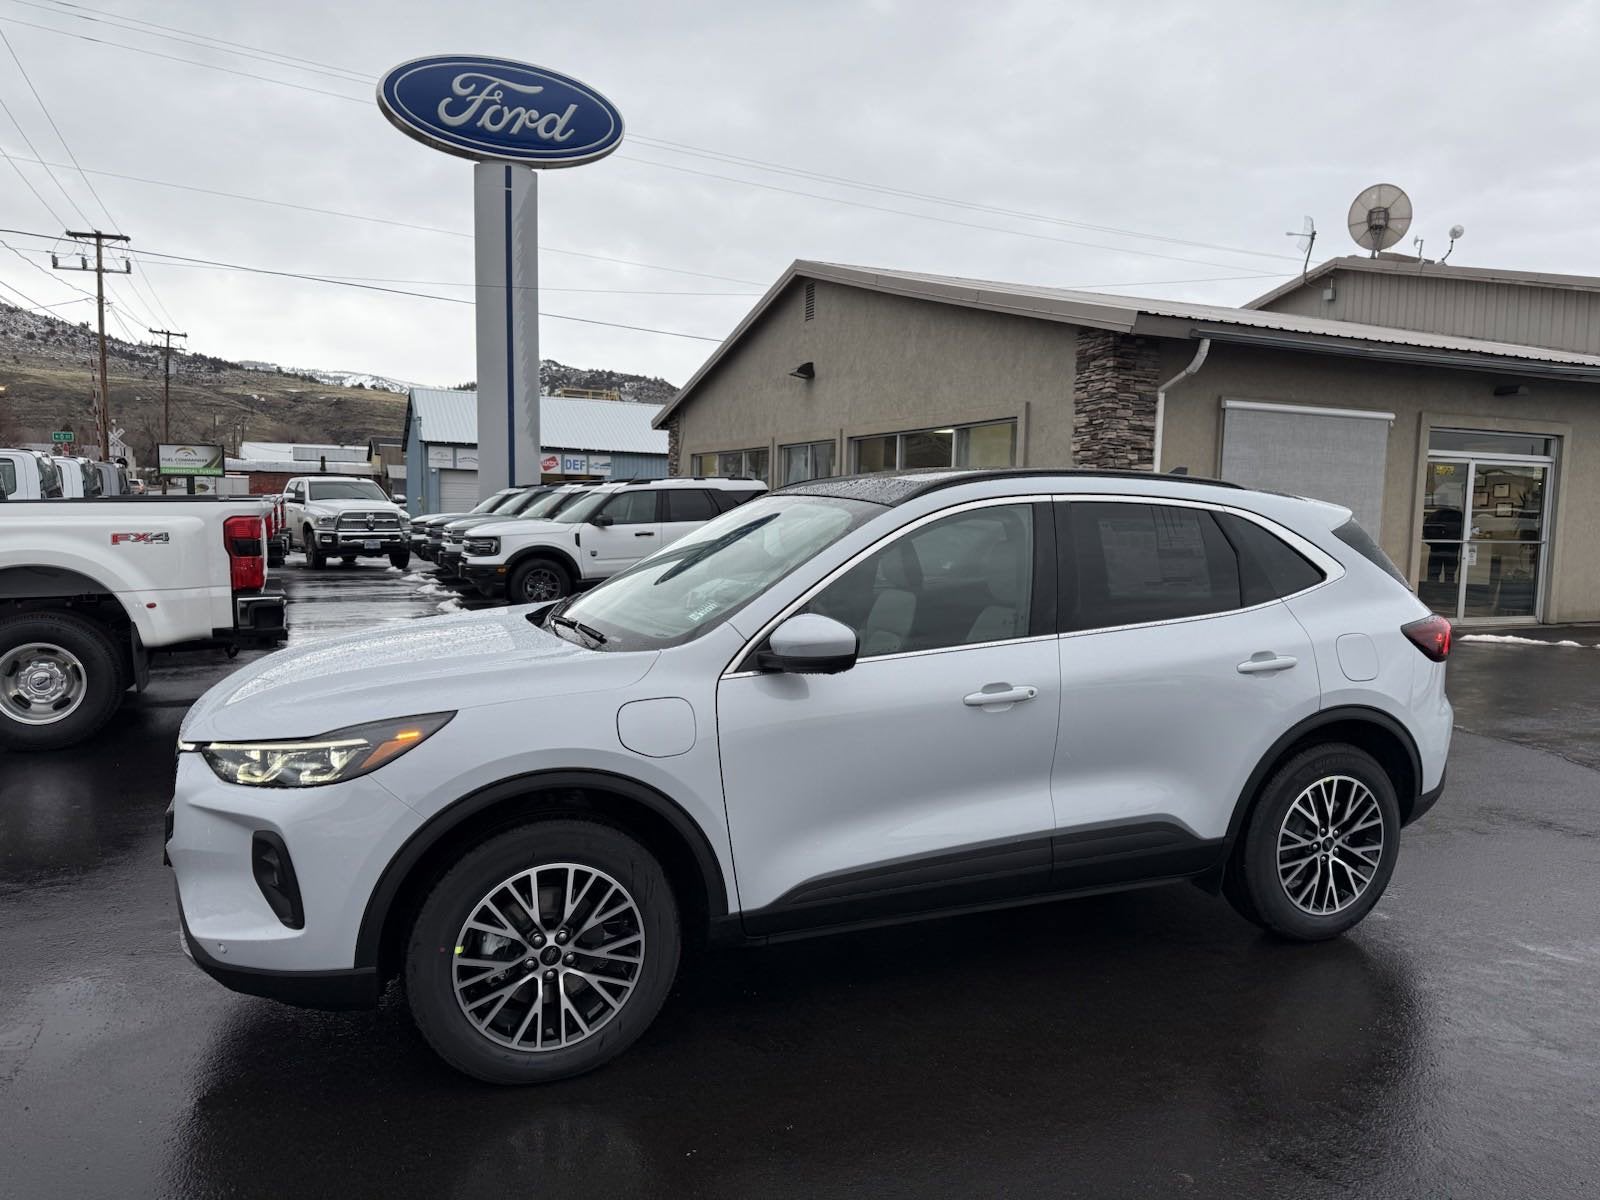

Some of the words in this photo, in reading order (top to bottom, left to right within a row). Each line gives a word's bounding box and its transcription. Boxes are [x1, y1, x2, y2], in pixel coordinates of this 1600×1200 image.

[437, 72, 579, 142] Ford
[565, 458, 586, 470] DEF
[111, 532, 170, 545] FX4
